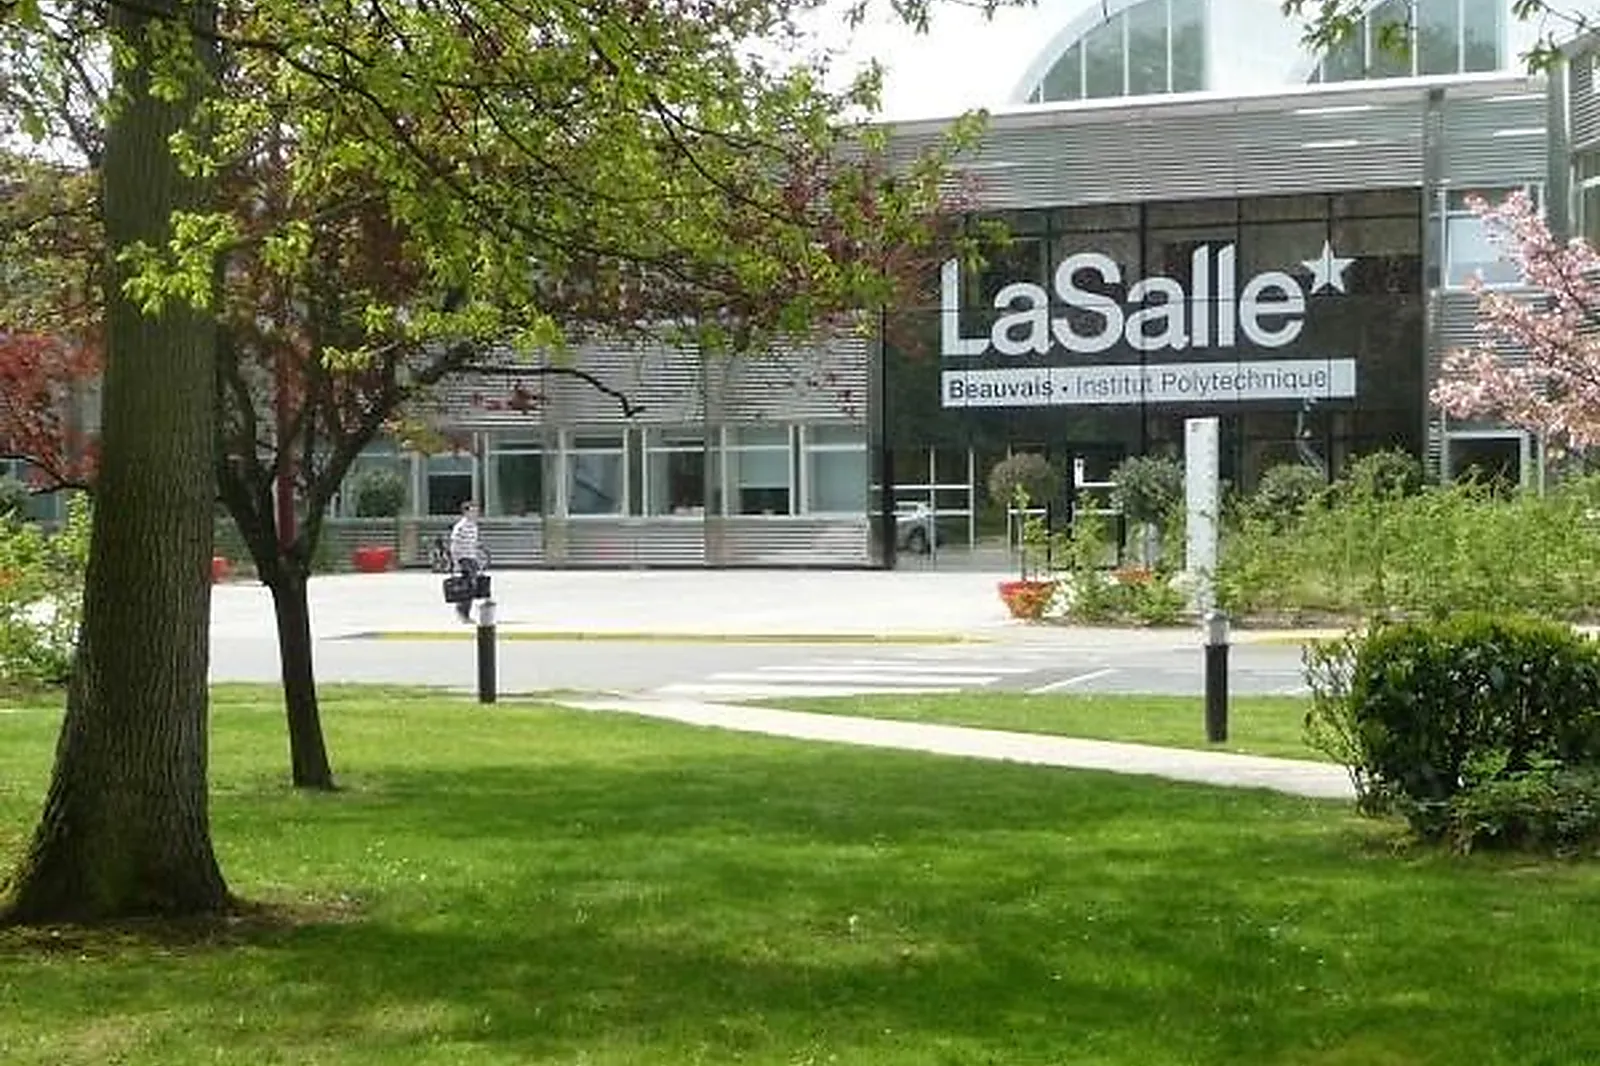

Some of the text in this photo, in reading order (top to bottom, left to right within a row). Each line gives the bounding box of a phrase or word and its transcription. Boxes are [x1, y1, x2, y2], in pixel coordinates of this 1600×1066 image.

[940, 243, 1306, 355] LaSalle
[948, 367, 1327, 400] Beauvais Institut Polytechnique
